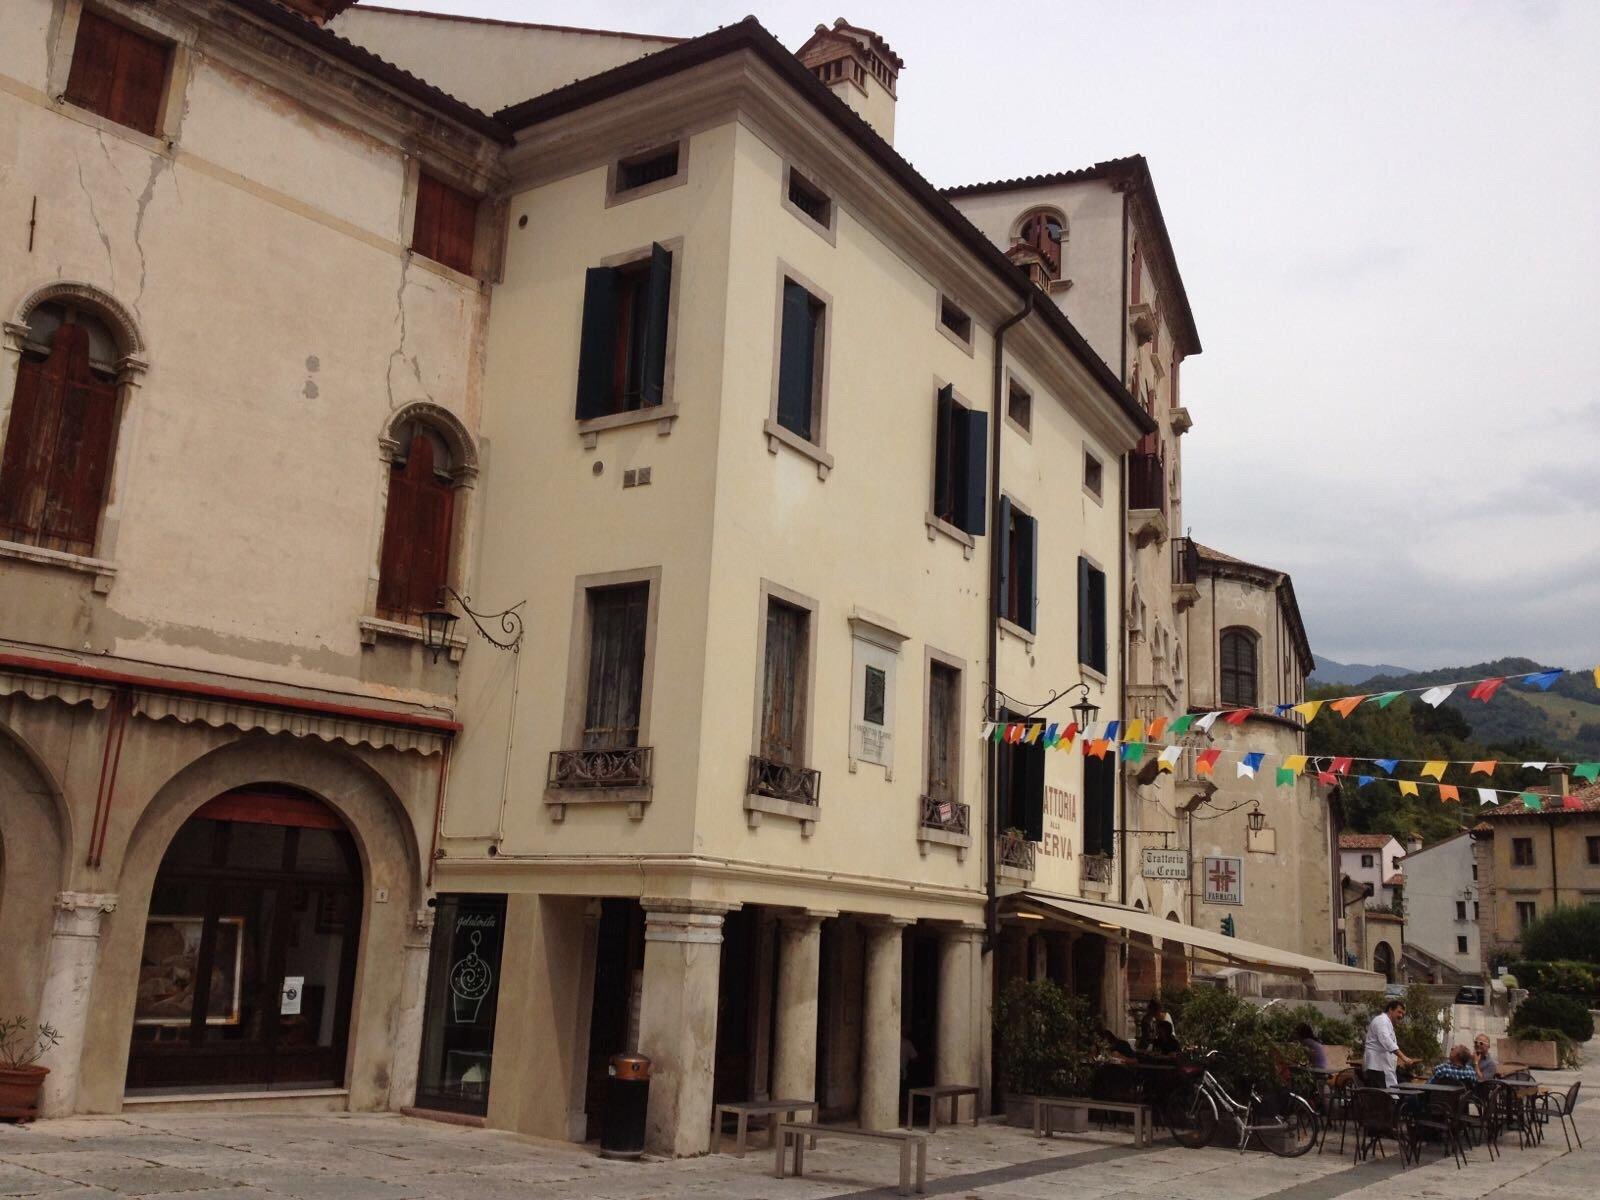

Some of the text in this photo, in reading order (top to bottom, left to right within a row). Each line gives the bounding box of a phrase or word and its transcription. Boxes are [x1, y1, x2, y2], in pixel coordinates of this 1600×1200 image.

[1043, 785, 1077, 823] ATTORIA
[1146, 852, 1184, 864] Trattoria
[1157, 866, 1186, 877] Cerva
[1207, 892, 1237, 902] FARMACIA
